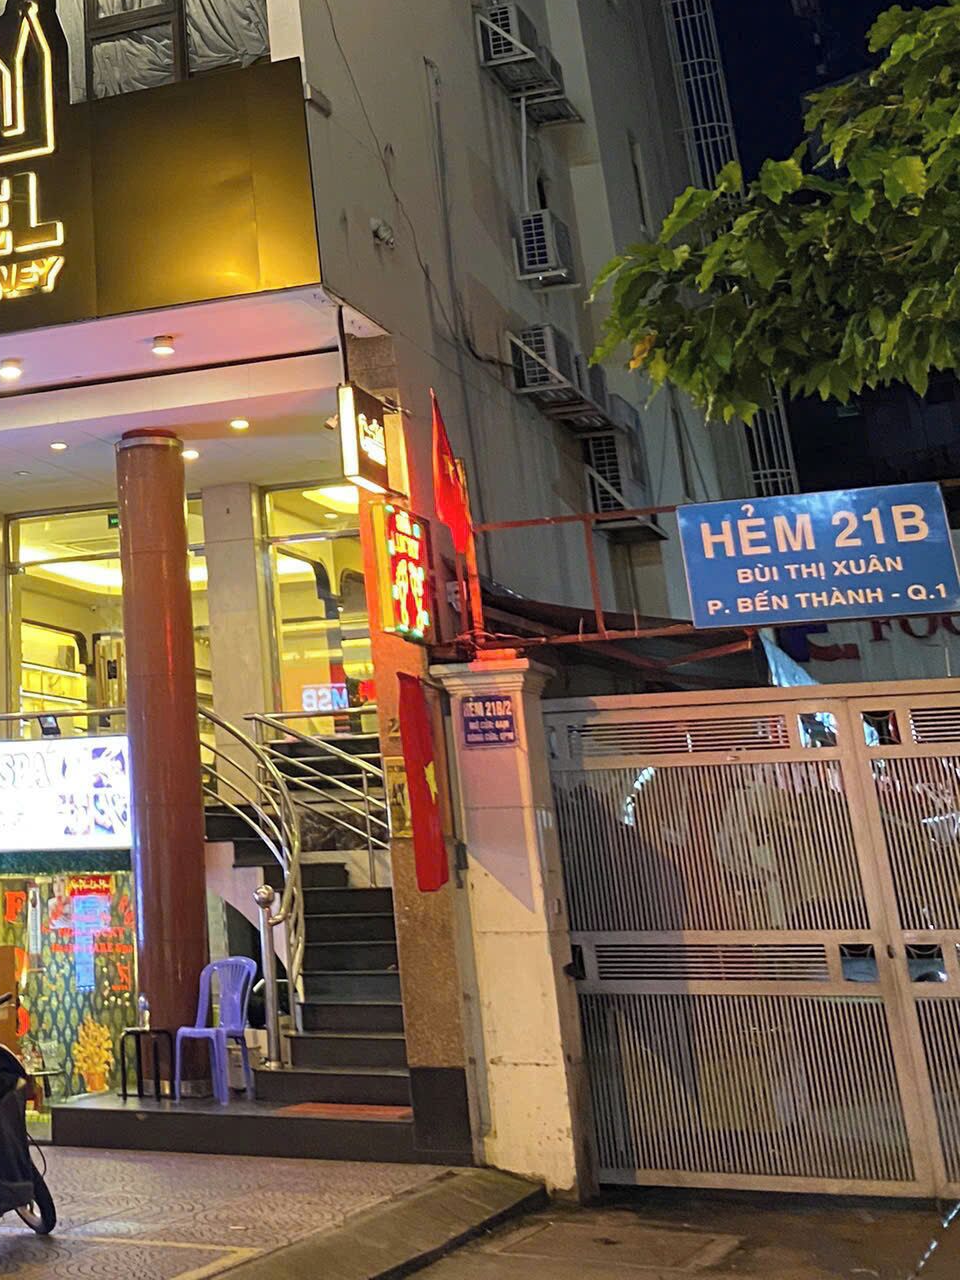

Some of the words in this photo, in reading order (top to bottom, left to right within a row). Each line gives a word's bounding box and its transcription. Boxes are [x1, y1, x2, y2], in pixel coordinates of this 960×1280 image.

[700, 504, 816, 558] HẺM
[831, 504, 930, 548] 21B
[737, 564, 778, 584] BÙI
[784, 562, 825, 581] THỊ
[832, 554, 904, 576] XUÂN
[707, 599, 730, 616] P.
[737, 590, 789, 613] BẾN
[795, 587, 884, 610] THÀNH
[907, 583, 947, 600] Q.1
